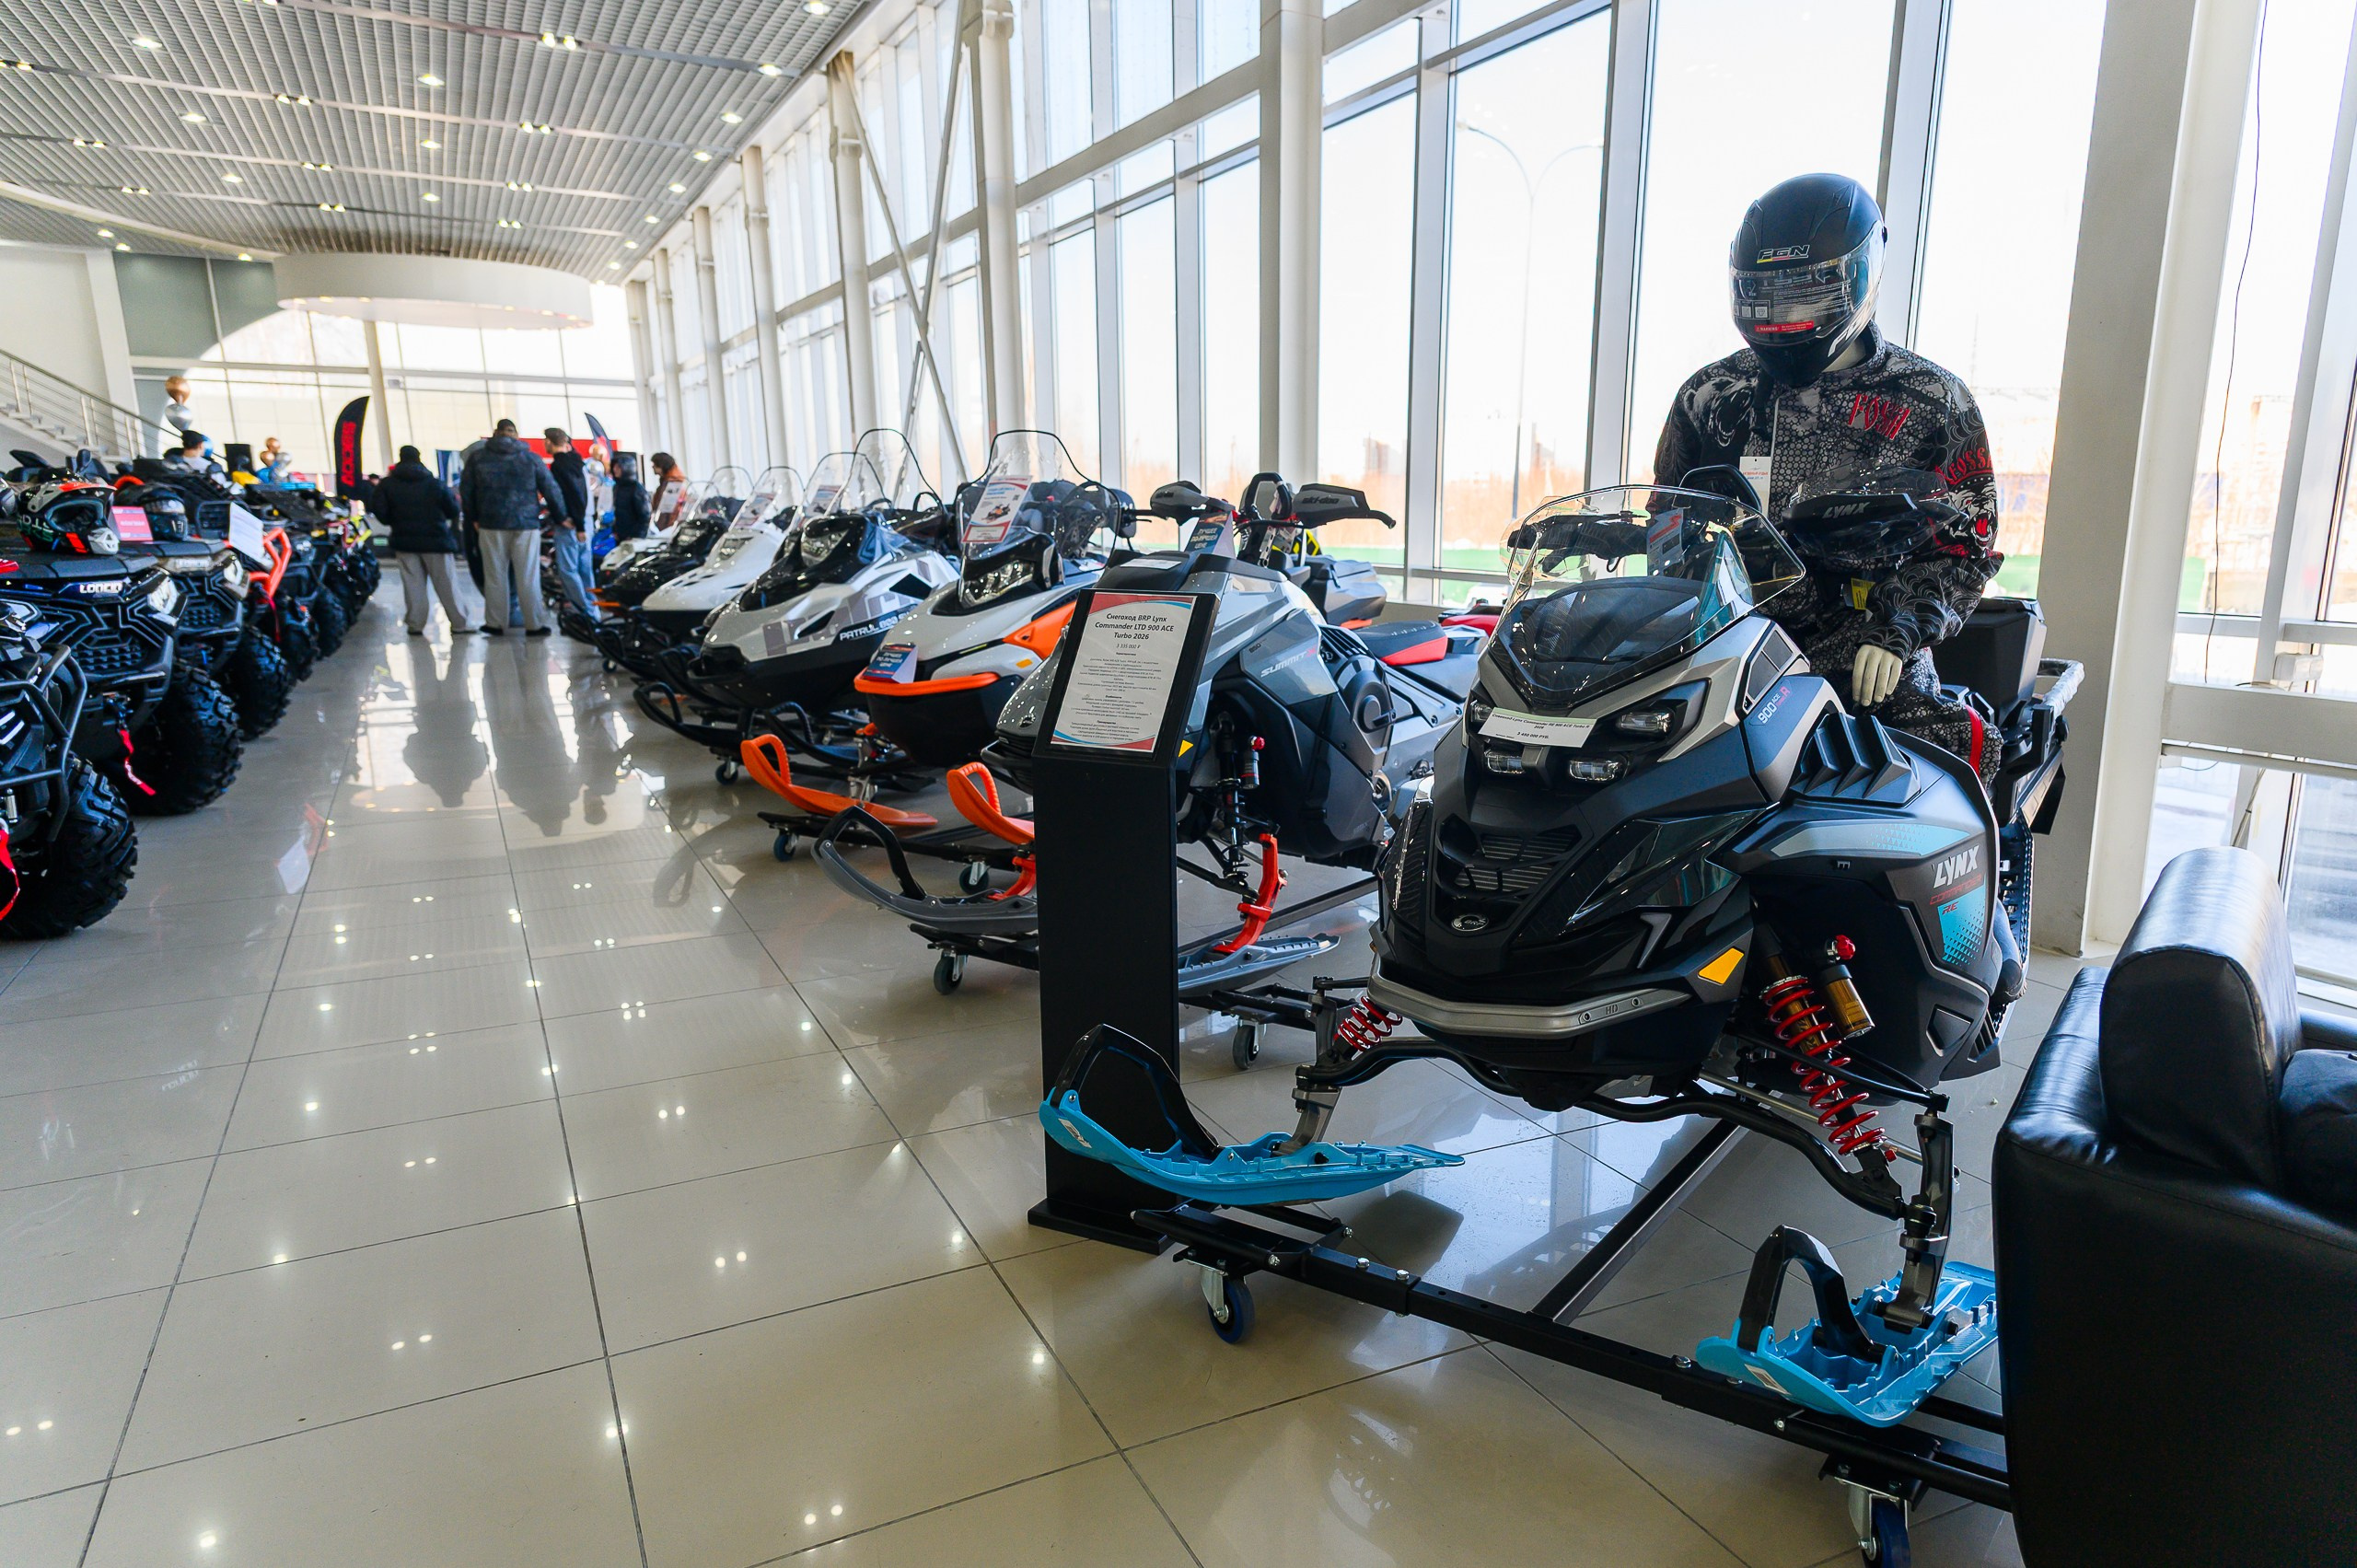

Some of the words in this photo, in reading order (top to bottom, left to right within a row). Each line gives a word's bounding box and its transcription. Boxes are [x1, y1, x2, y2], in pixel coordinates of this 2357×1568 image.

[1758, 245, 1810, 262] FGN
[1822, 502, 1870, 518] LYNX
[1095, 621, 1133, 630] Commander
[1107, 613, 1136, 621] Снегоход
[1152, 615, 1167, 623] Lynx
[1758, 702, 1777, 724] 900
[1771, 693, 1781, 703] ACE
[1780, 686, 1791, 696] R
[1933, 845, 1980, 889] LYNX
[1942, 901, 1959, 915] RE
[1606, 1004, 1619, 1015] HD
